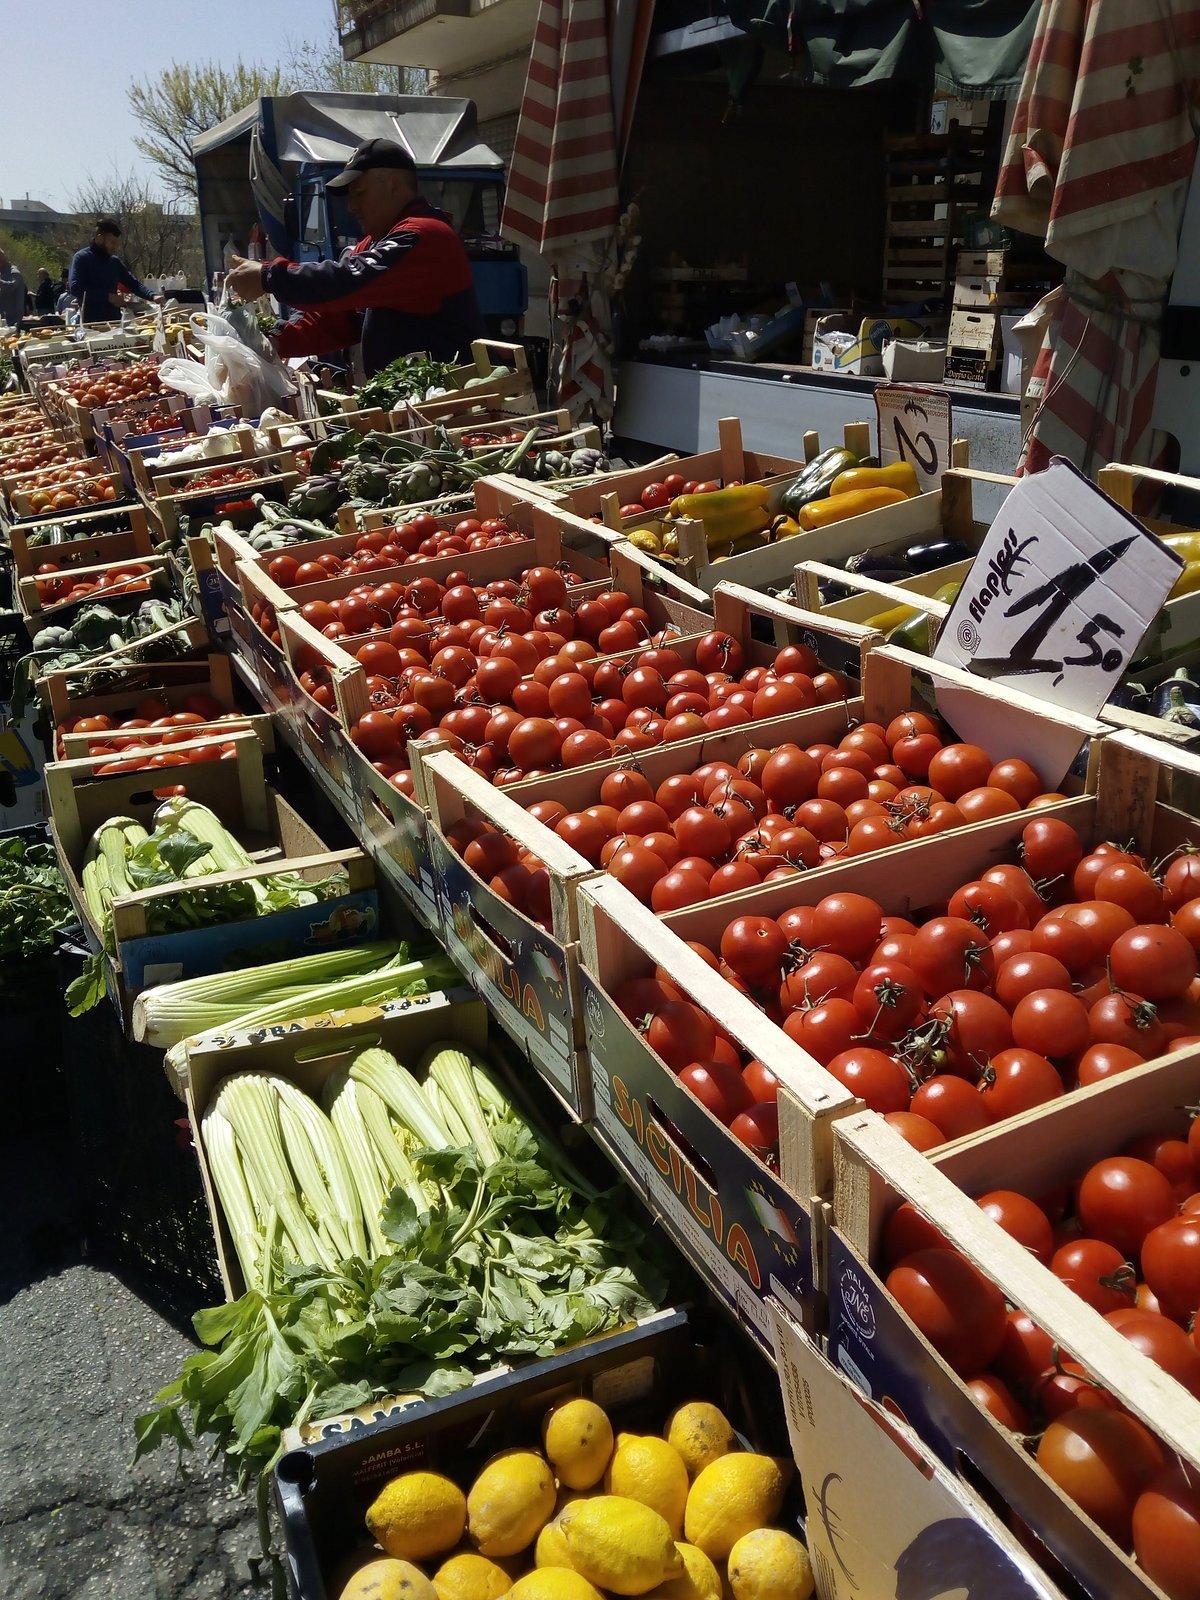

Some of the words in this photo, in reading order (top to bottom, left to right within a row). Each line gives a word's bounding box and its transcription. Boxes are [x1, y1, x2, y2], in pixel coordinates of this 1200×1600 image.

[612, 1075, 761, 1290] SICILIA
[846, 1268, 870, 1303] ITALIA
[361, 1449, 402, 1466] SAMBA
[405, 1442, 424, 1452] S.L.
